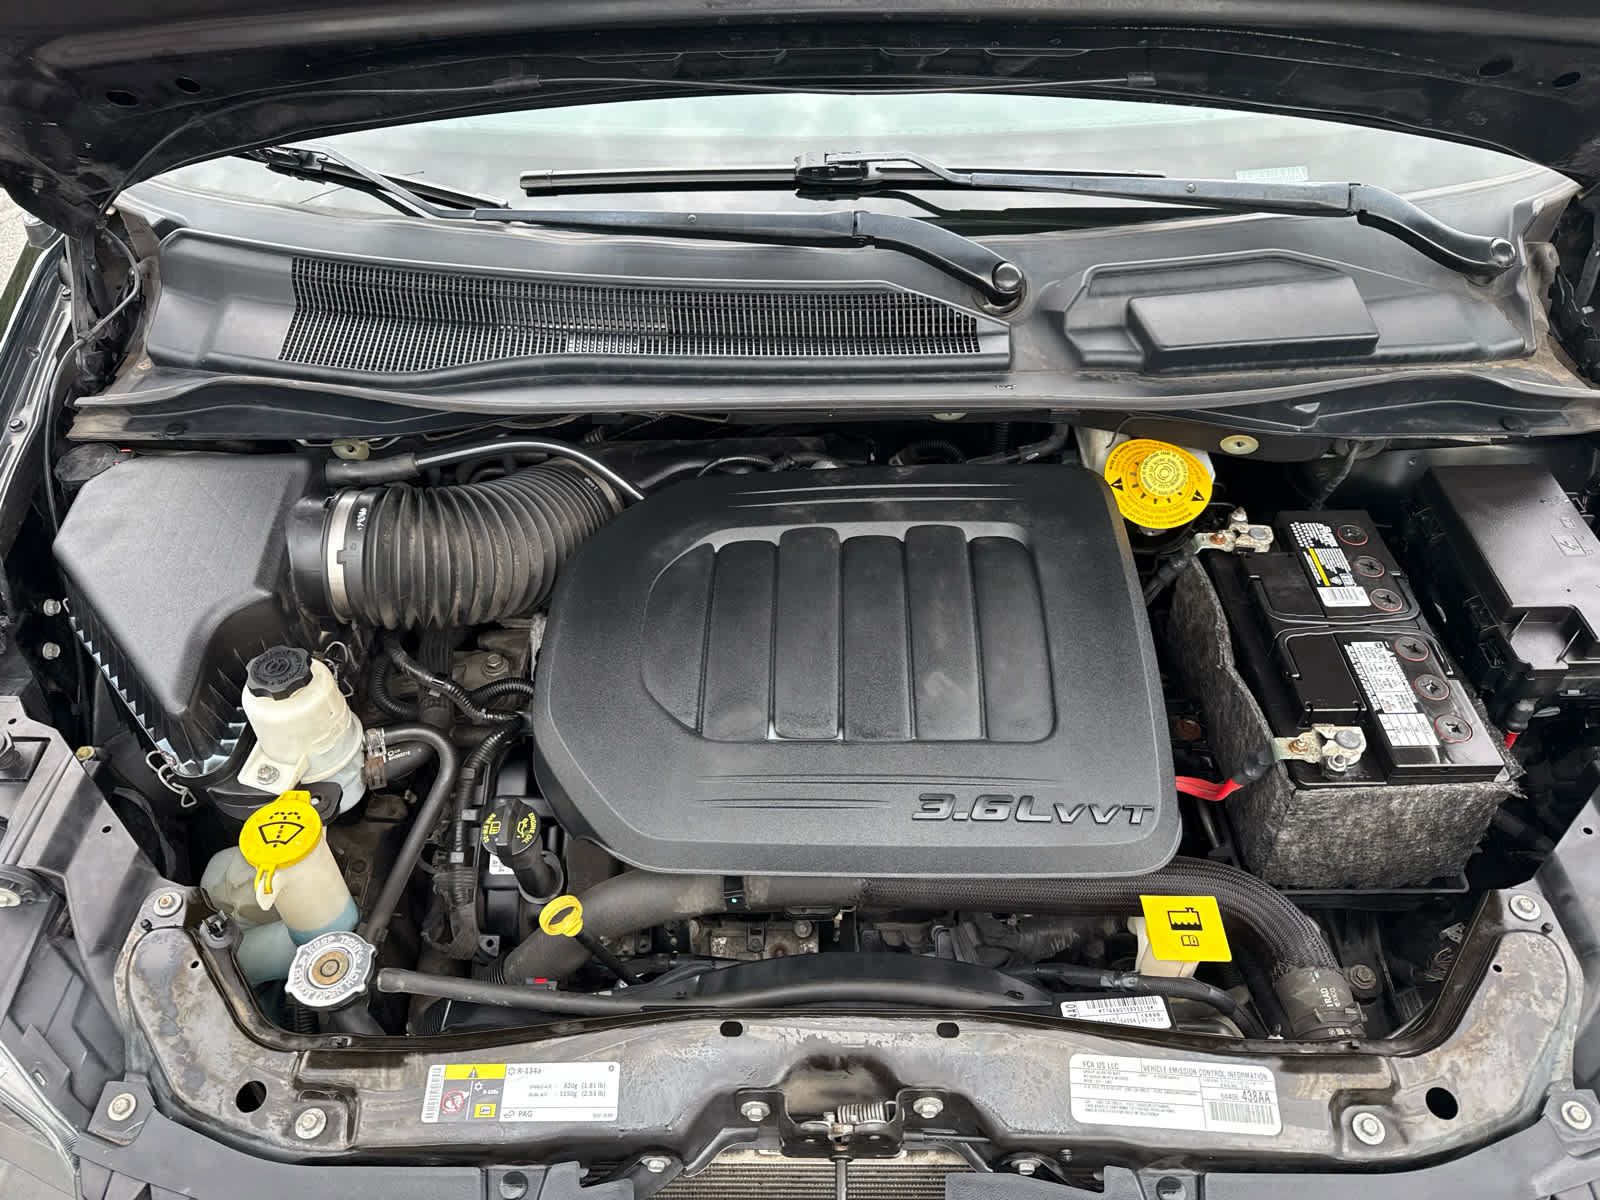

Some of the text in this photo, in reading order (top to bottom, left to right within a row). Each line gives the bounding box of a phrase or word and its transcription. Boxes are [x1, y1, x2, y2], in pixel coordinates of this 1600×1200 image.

[912, 793, 1154, 825] 3.6L VVT
[528, 812, 537, 833] ENGINE
[344, 968, 362, 988] HOT
[1143, 1064, 1268, 1081] VEHICLE EMISSION CONTROL INFORMATION
[1242, 1090, 1271, 1104] 438AA
[518, 1110, 534, 1118] PAG
